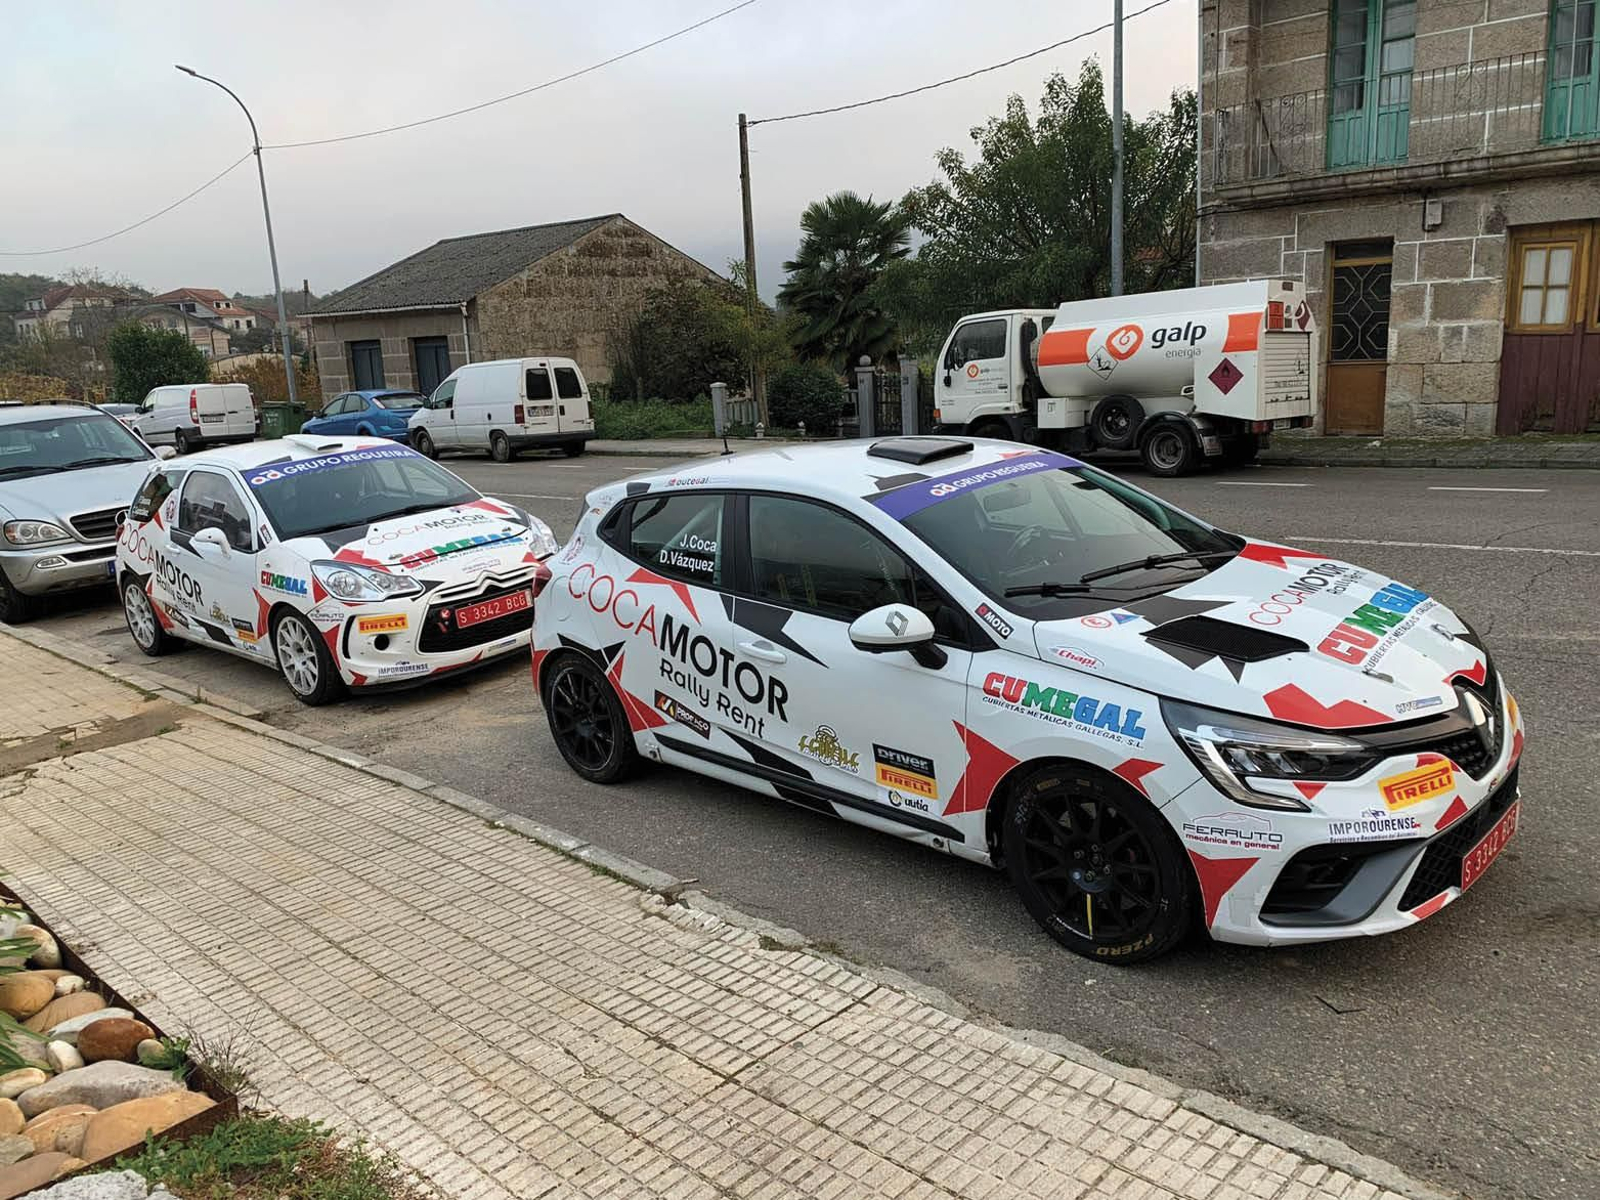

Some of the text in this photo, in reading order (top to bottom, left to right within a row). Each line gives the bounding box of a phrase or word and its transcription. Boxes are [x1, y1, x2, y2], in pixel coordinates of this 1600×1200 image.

[1151, 321, 1207, 350] galp
[1165, 347, 1202, 359] energia
[284, 457, 341, 475] GRUPO
[341, 450, 417, 463] REGUEIRA
[952, 472, 996, 489] GRUPO
[993, 460, 1049, 479] REGUEIRA
[679, 533, 718, 552] J.Coca
[660, 549, 715, 573] D.Vázquez
[359, 615, 406, 632] PIRELLI
[459, 611, 468, 624] S
[473, 602, 500, 621] 3342
[983, 611, 1012, 638] MOTO
[1317, 582, 1432, 665] CUMEGAL
[1057, 648, 1098, 667] Chapi
[659, 657, 765, 739] Rally Rent
[982, 696, 1026, 715] CUBIERTAS
[982, 671, 1147, 741] CUMEGAL
[881, 768, 933, 795] PIRELLI
[1382, 766, 1453, 806] PIRELLI
[1182, 822, 1283, 843] FERAUTO
[1328, 816, 1418, 837] IMPOROURENSE
[1230, 839, 1242, 847] en
[1244, 841, 1280, 851] general
[1465, 860, 1472, 883] S
[1475, 830, 1500, 872] 3342
